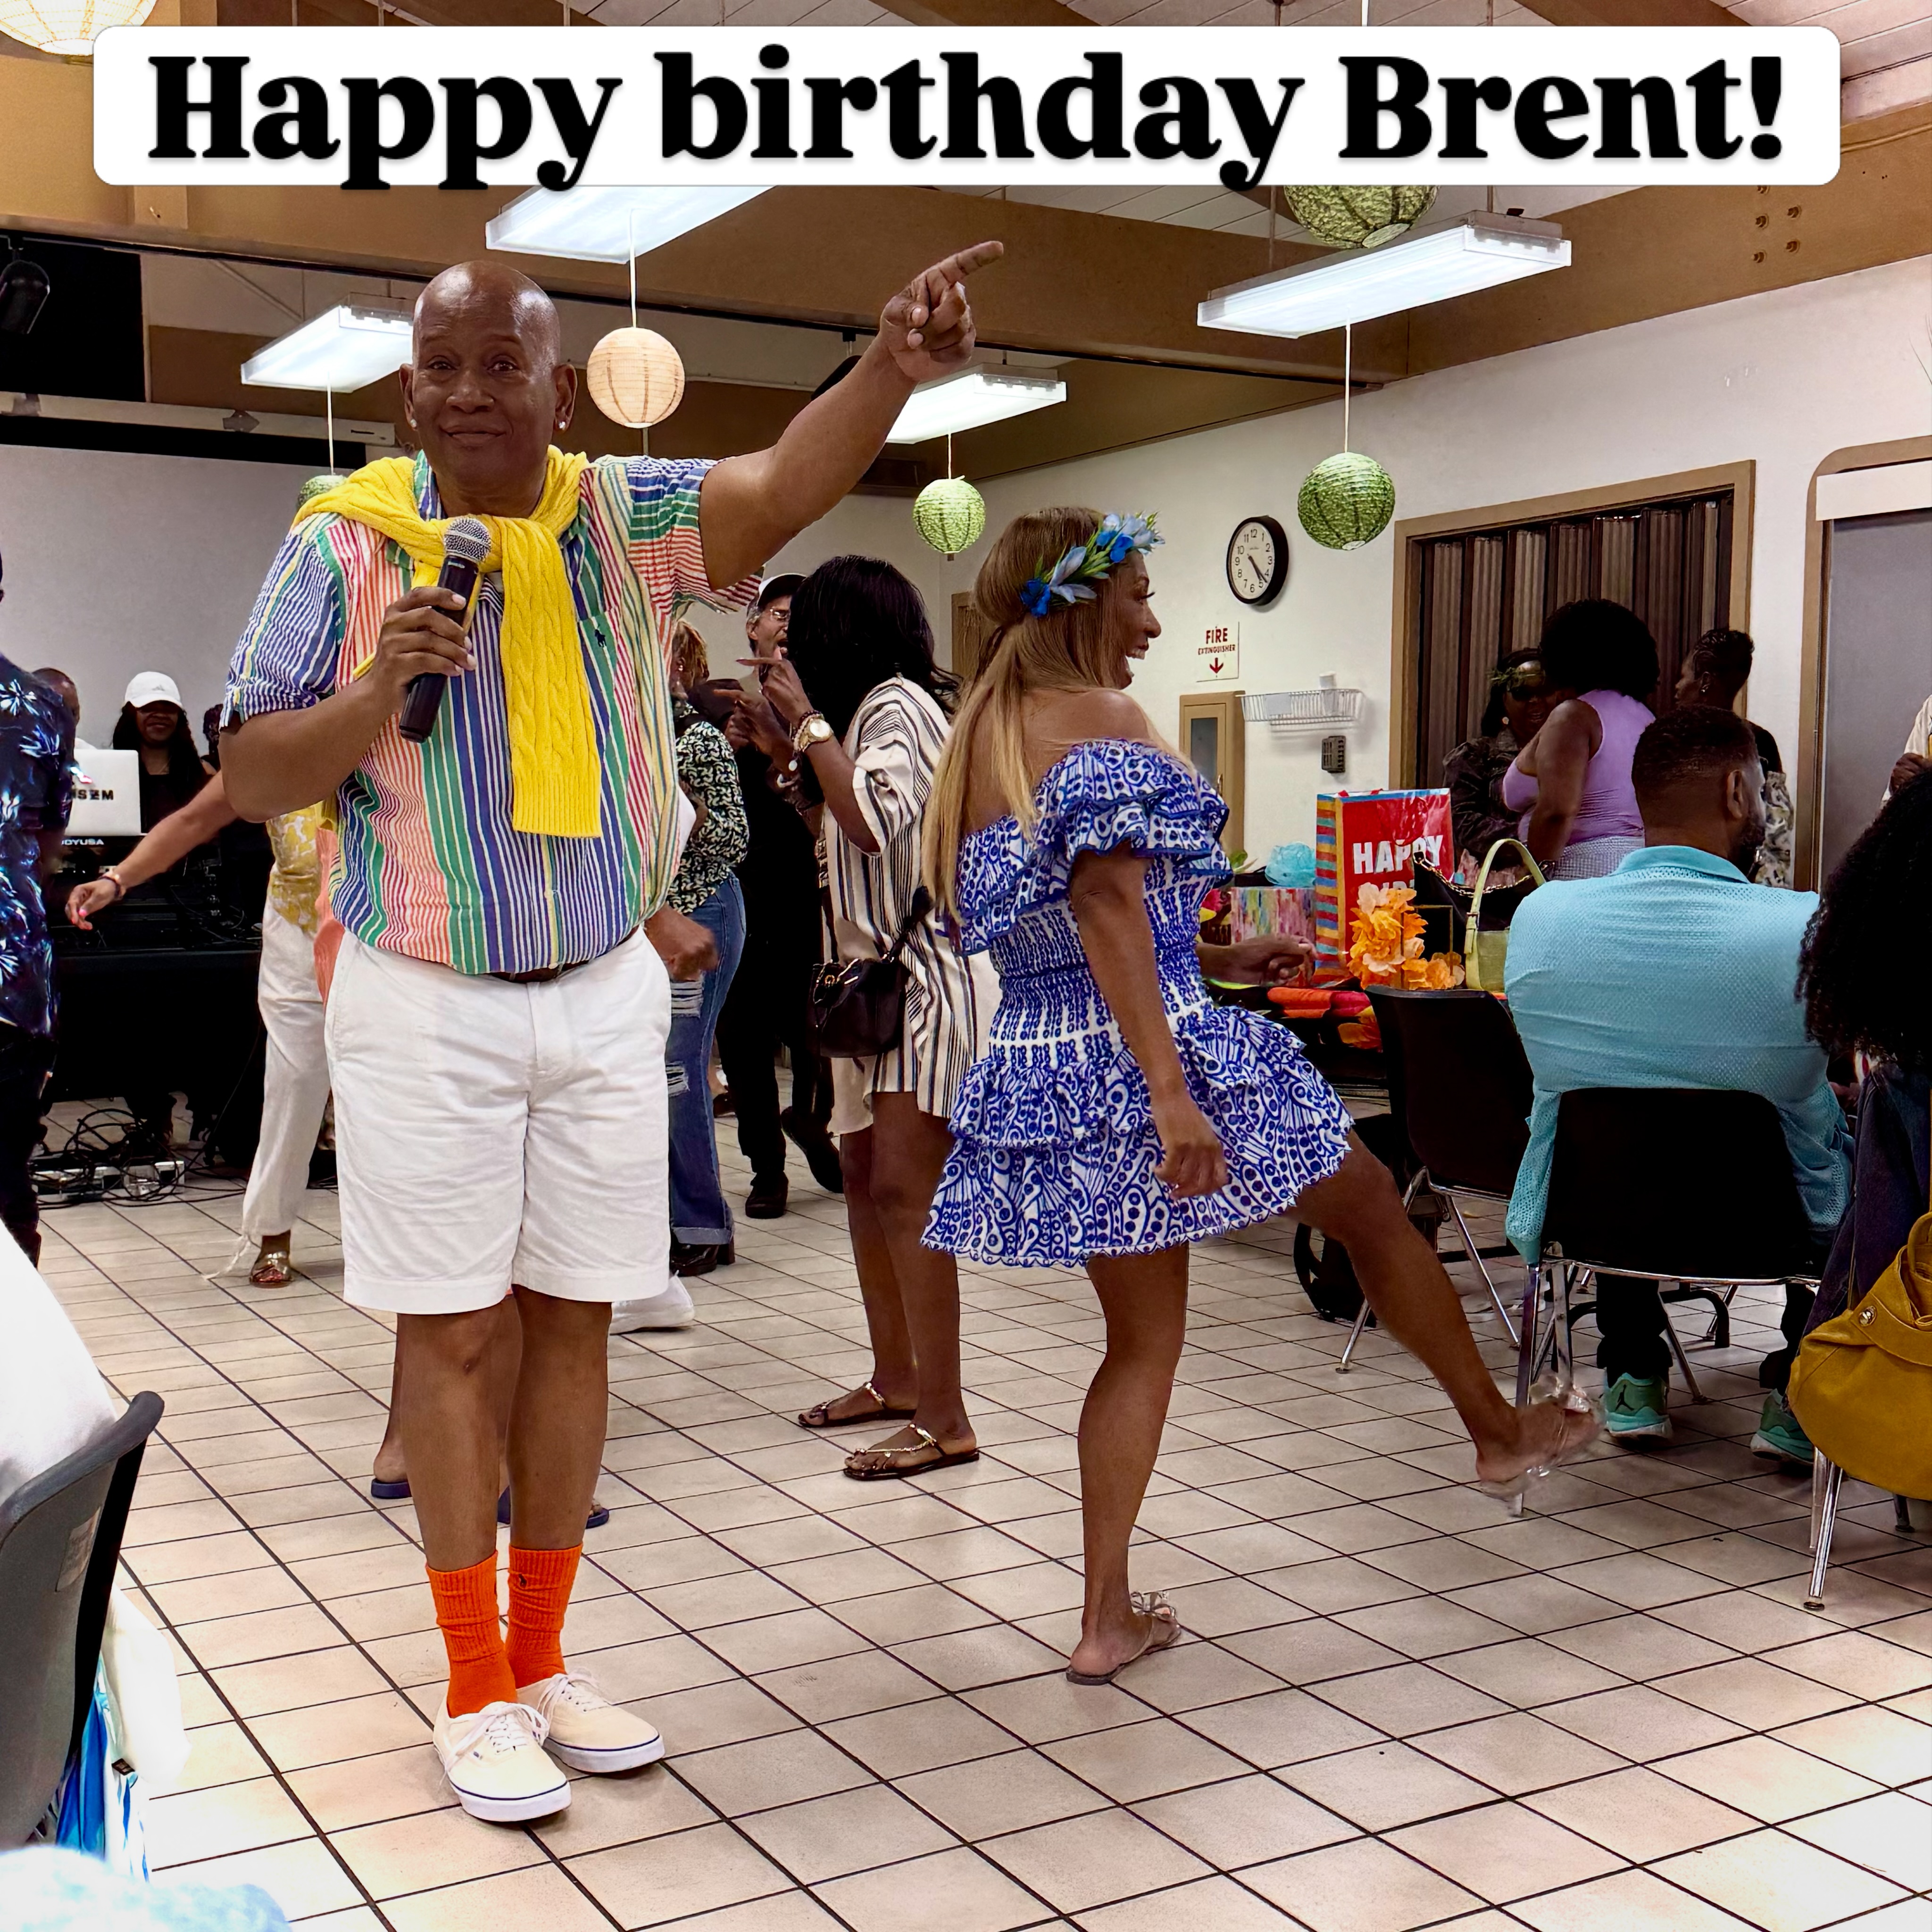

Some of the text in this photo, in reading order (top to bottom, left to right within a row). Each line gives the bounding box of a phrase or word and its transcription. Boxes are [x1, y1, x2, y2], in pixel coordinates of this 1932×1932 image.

[1250, 529, 1257, 538] 12
[1262, 533, 1264, 541] 1
[1244, 534, 1249, 543] 11
[1237, 545, 1245, 555] 10
[1266, 543, 1271, 552] 2
[1235, 557, 1240, 566] 9
[1267, 556, 1273, 565] 3
[1238, 569, 1242, 578] 8
[1243, 579, 1248, 588] 7
[1250, 583, 1255, 593] 6
[1258, 579, 1264, 588] 5
[1206, 628, 1228, 644] FIRE
[1198, 644, 1235, 655] EXTINGUISHER
